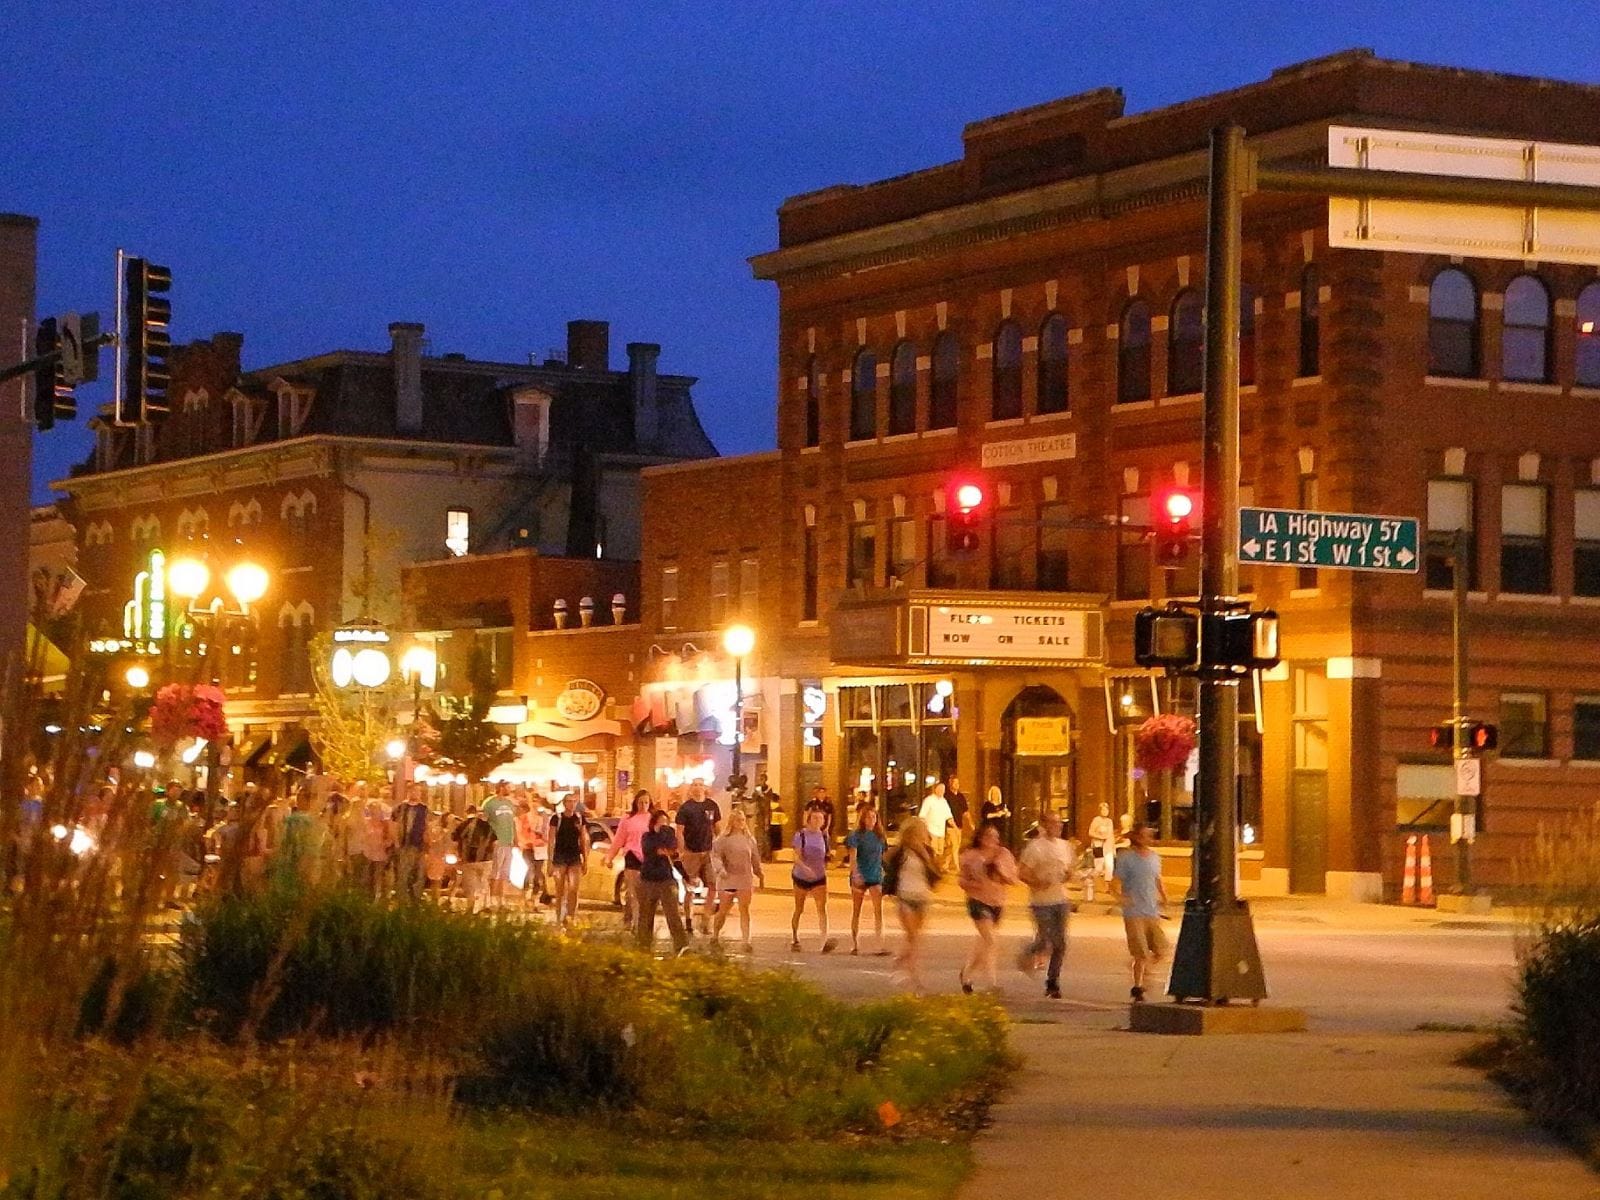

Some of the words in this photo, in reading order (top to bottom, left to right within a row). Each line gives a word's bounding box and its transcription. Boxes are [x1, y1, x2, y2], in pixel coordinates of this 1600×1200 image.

[1258, 512, 1279, 534] IA
[1288, 513, 1374, 542] Highway
[1379, 520, 1402, 543] 57
[1265, 539, 1277, 560] E
[1282, 540, 1292, 561] 1
[1297, 542, 1318, 564] St
[1332, 543, 1353, 565] W
[1357, 543, 1367, 565] 1
[1372, 545, 1392, 567] St
[1013, 615, 1065, 626] TICKETS
[943, 633, 971, 643] NOW
[998, 635, 1014, 644] ON
[1038, 635, 1071, 646] SALE
